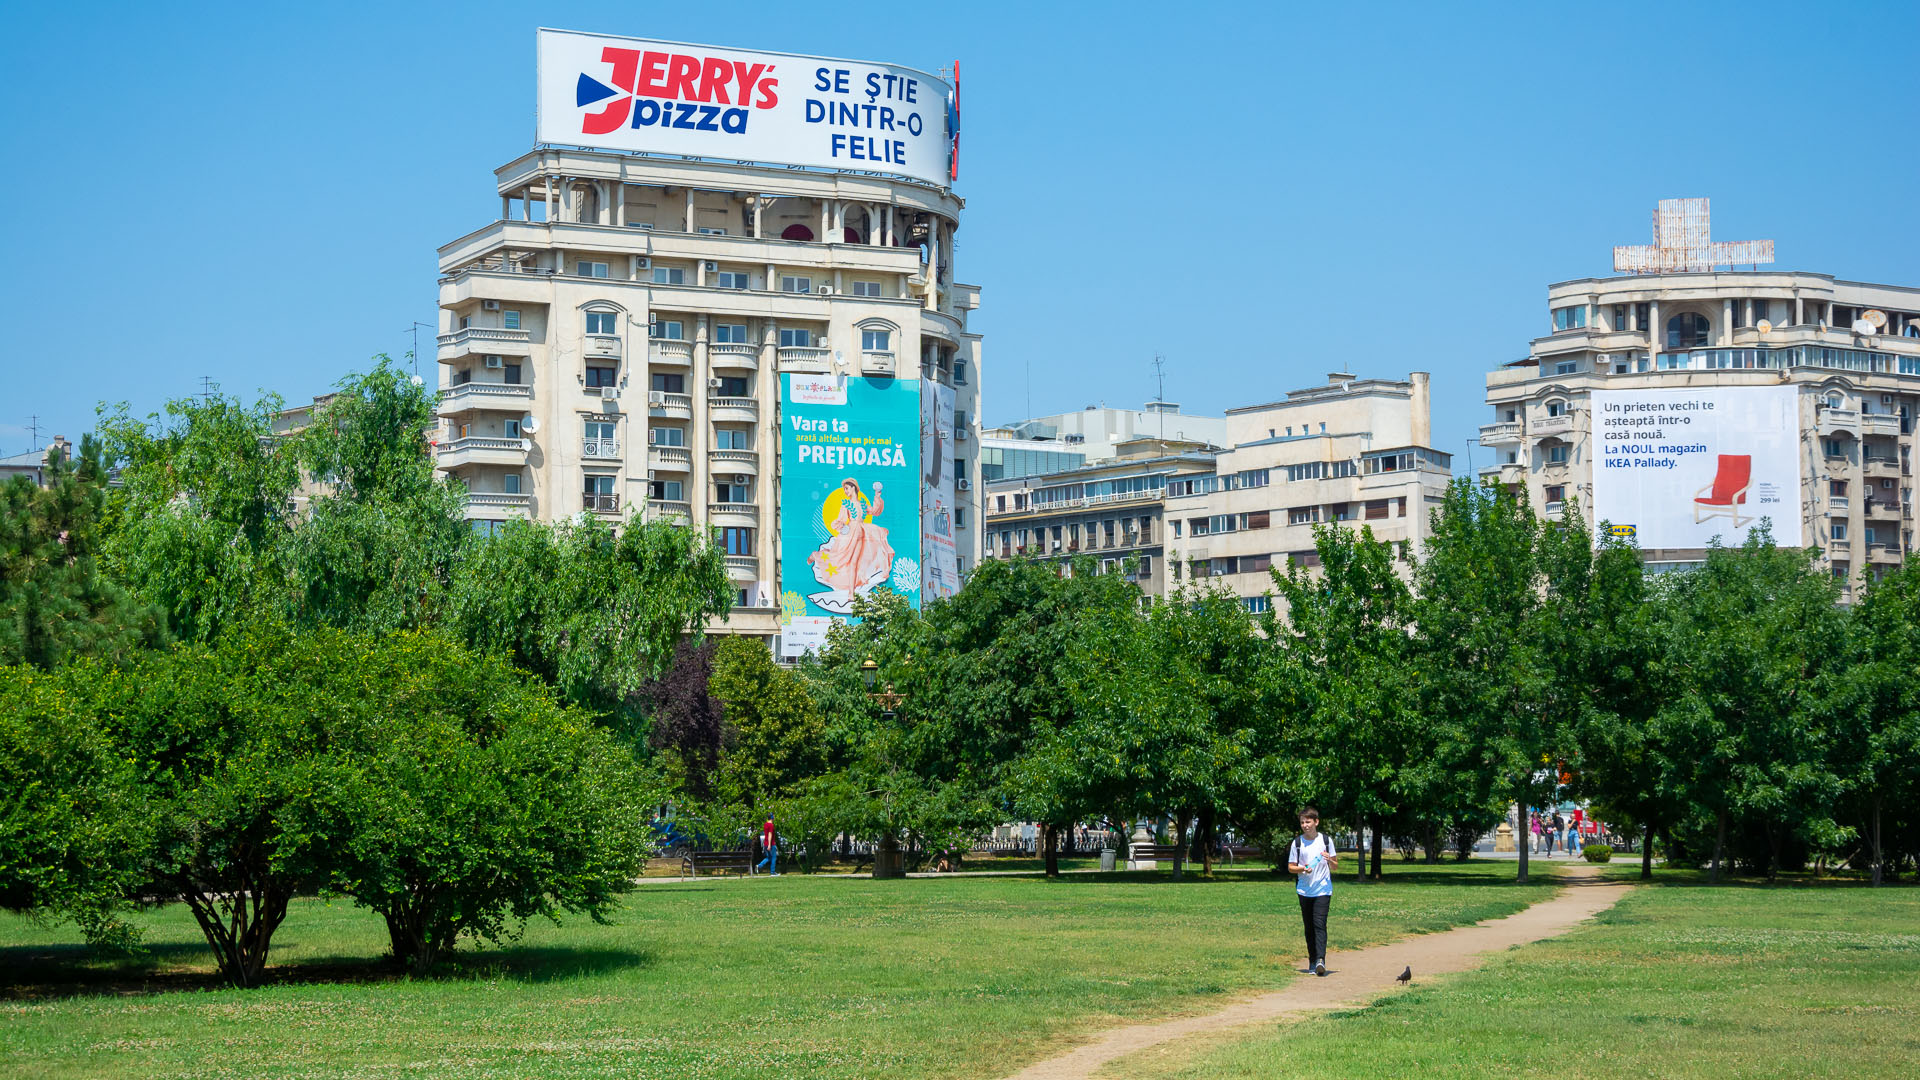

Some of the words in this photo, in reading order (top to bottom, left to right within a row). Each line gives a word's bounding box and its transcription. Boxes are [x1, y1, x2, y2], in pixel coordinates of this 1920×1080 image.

[814, 67, 850, 94] SE
[631, 99, 748, 135] pizza
[806, 99, 922, 137] DINTR-O
[831, 133, 906, 165] FELIE
[1604, 402, 1620, 412] Un
[1623, 401, 1666, 414] prieten
[1668, 400, 1699, 411] vechi
[1702, 401, 1714, 410] te
[790, 415, 828, 432] Vara
[831, 418, 849, 433] ta
[1657, 415, 1691, 425] într-o
[863, 436, 875, 446] pic
[876, 436, 892, 445] mai
[1604, 430, 1630, 440] casă
[1633, 429, 1666, 440] nouă.
[1605, 445, 1619, 454] La
[1621, 444, 1655, 454] NOUL
[1658, 443, 1707, 456] magazin
[1605, 458, 1632, 468] IKEA
[1634, 457, 1678, 470] Pallady.
